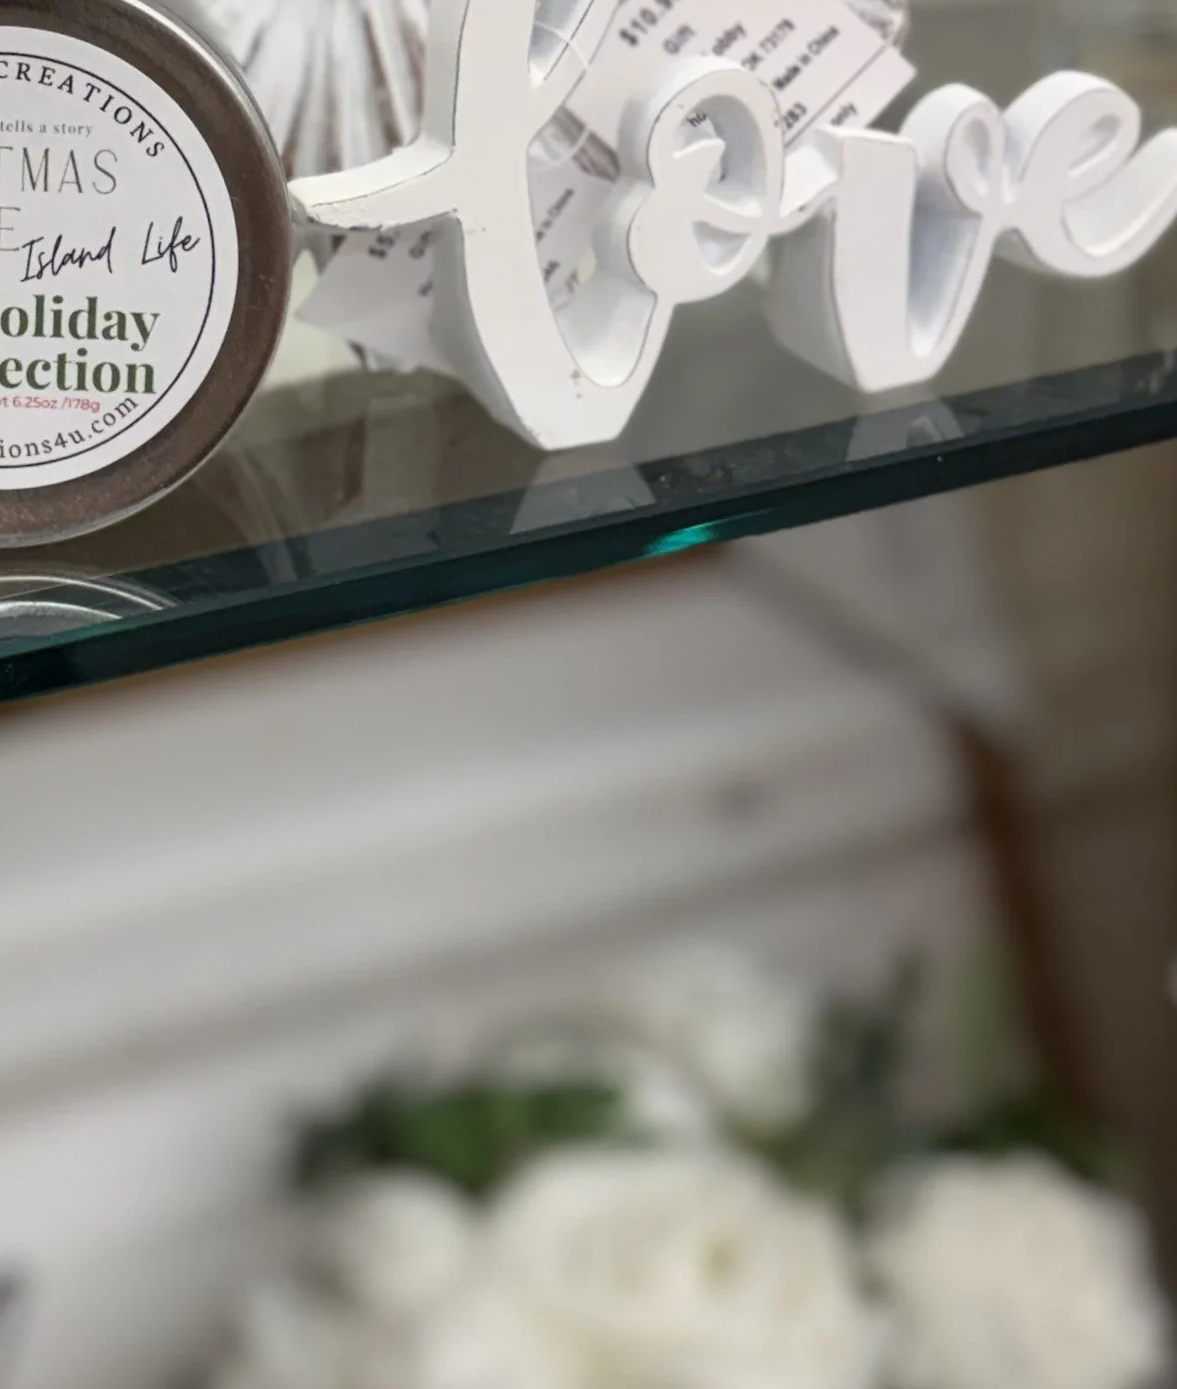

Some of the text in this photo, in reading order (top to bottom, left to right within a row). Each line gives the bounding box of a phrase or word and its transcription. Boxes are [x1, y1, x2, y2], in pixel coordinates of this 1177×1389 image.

[703, 21, 746, 57] obby
[772, 26, 840, 92] Made in China
[0, 120, 33, 133] tells
[39, 123, 47, 133] a
[53, 122, 94, 137] story
[20, 215, 201, 282] Island Life
[12, 396, 58, 409] 6.25oz
